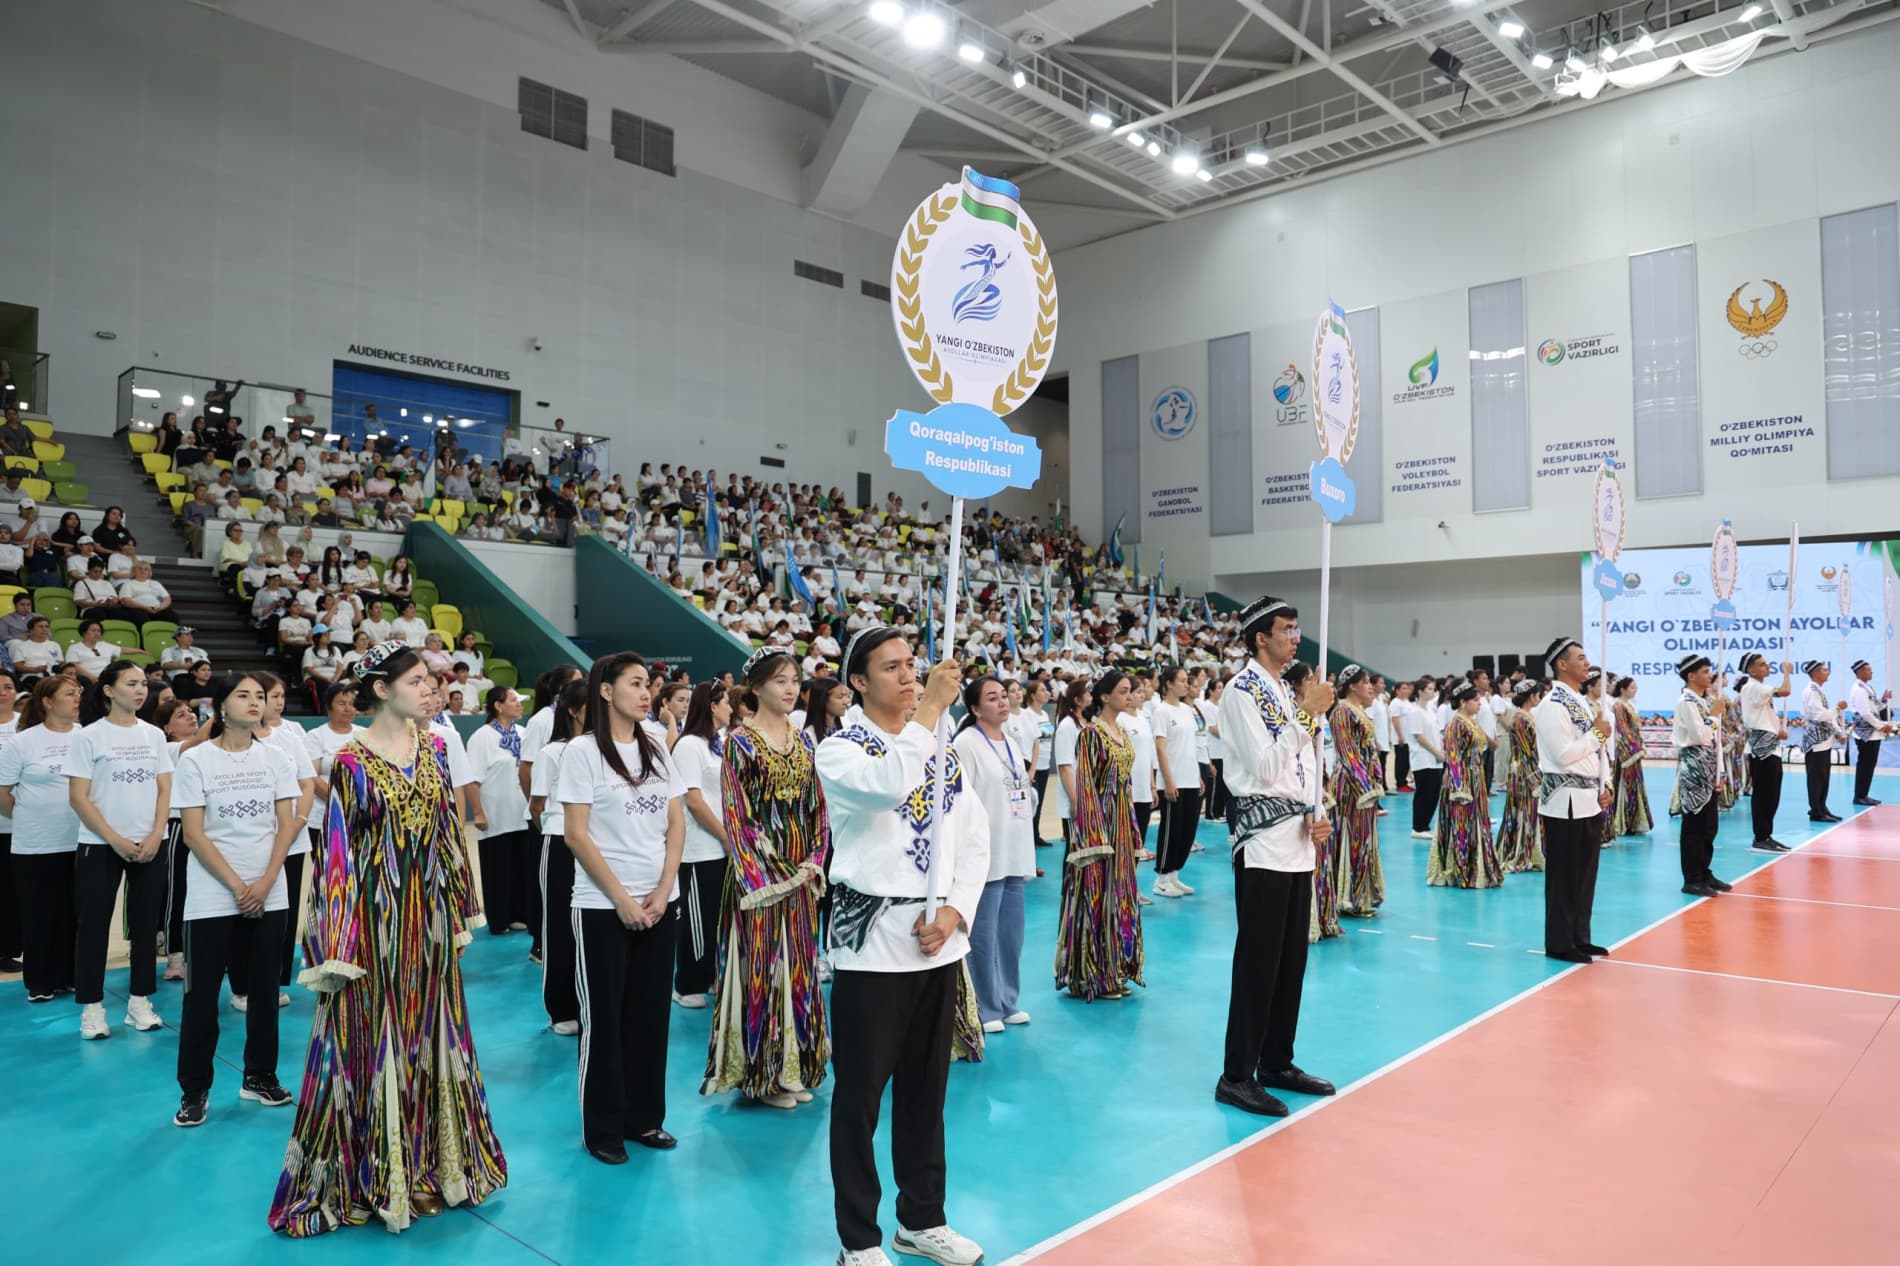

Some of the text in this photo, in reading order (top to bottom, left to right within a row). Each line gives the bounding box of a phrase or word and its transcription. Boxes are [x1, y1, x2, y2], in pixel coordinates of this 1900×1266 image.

[936, 333, 1015, 358] YANGI O'ZBEKISTON
[1568, 339, 1601, 351] SPORT
[1568, 345, 1619, 361] VAZIRLIGI
[348, 344, 510, 381] AUDIENCE SERVICE FACILITIES
[1720, 415, 1803, 432] O'ZBEKISTON
[909, 420, 1024, 456] Qoraqalpog'iston
[1710, 427, 1814, 446] MILLIY OLIMPIYA
[1545, 437, 1616, 453] O'ZBEKISTON
[1730, 443, 1793, 458] QO'MITASI
[925, 450, 1012, 478] Respublikasi
[1395, 456, 1456, 470] O'ZBEKISTON
[1542, 450, 1619, 465] RESPUBLIKASI
[1401, 468, 1450, 480] VOLEYBOL
[1536, 462, 1626, 478] SPORT VAZIGI
[1265, 472, 1310, 484] O'ZBEKIST
[1151, 486, 1199, 498] O'ZBEKISTON
[1268, 484, 1310, 495] BASKETBO
[1391, 479, 1462, 493] FEDERATSIYASI
[1158, 498, 1192, 507] GANDBOL
[1148, 506, 1203, 518] FEDERATSIYASI
[1789, 616, 1875, 631] AYOLAR
